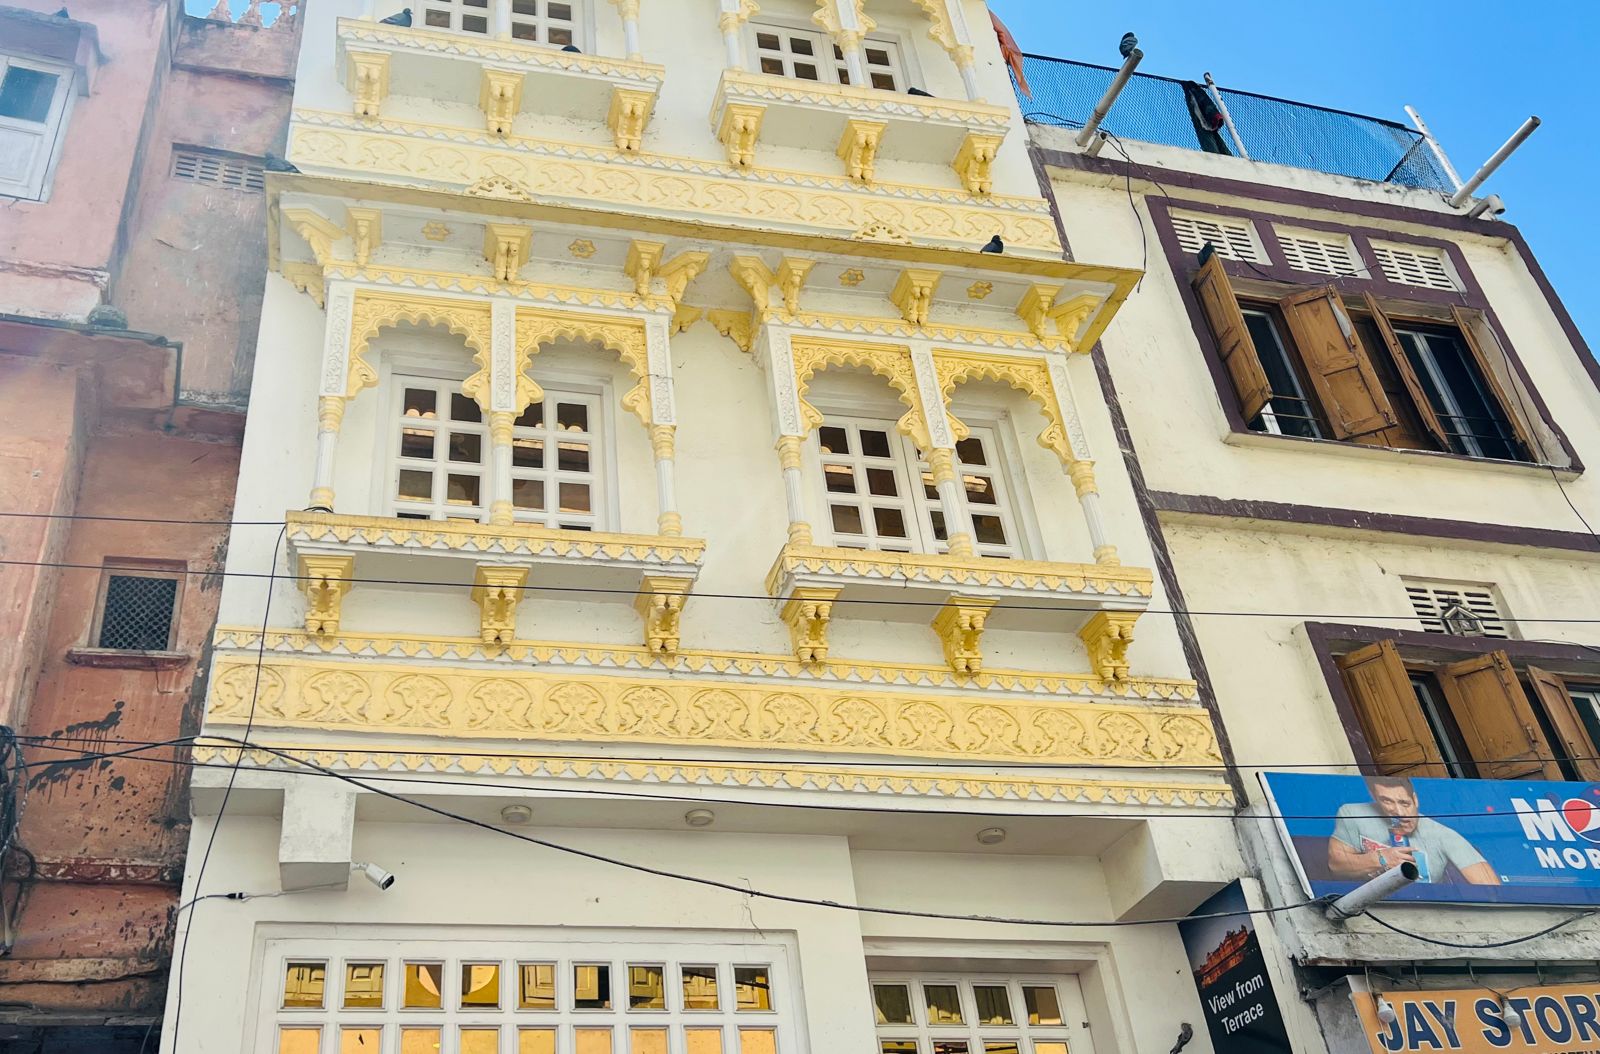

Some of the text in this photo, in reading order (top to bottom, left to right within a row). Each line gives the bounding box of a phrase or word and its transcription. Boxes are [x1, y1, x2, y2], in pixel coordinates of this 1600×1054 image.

[1208, 974, 1264, 1014] View from
[1221, 1003, 1264, 1035] Terrace
[1377, 994, 1600, 1051] JAY STOR
